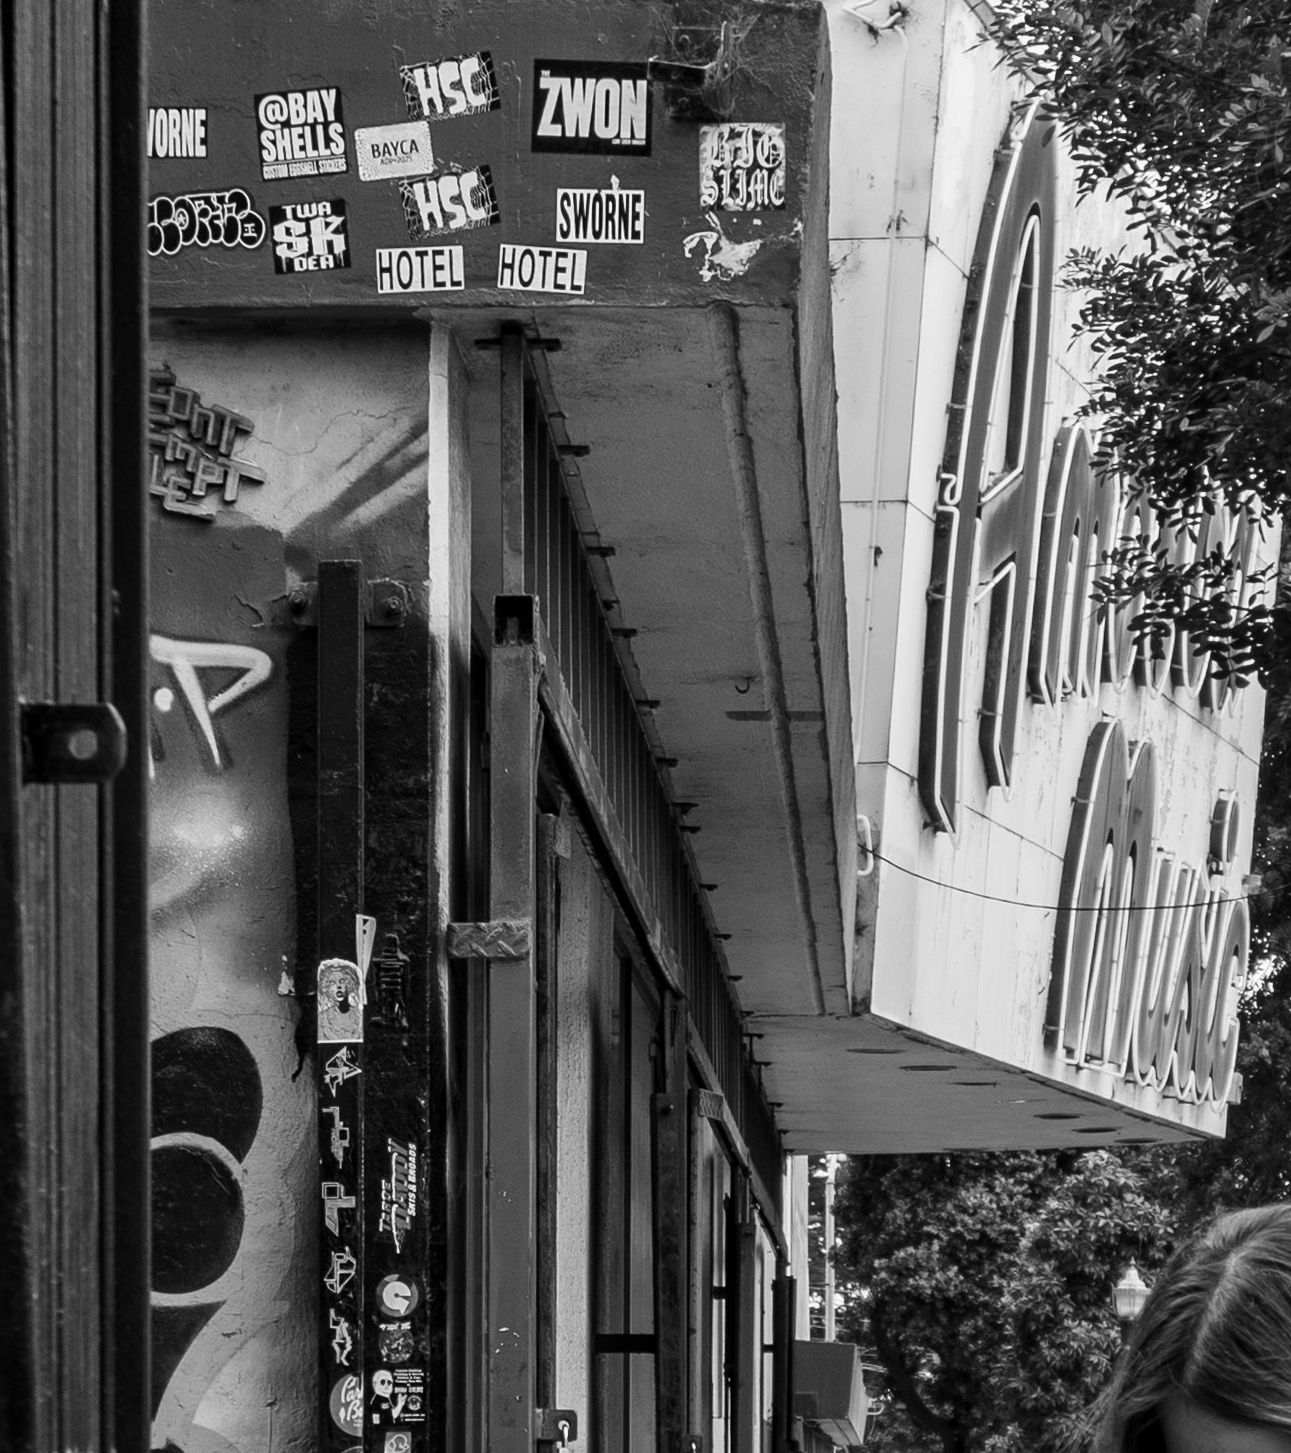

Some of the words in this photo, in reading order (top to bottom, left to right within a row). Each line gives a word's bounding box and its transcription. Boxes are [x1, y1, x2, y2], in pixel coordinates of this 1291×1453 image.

[413, 57, 487, 117] HSC
[537, 76, 647, 139] ZWON
[259, 89, 336, 130] @BAY
[260, 123, 345, 162] SHELLS
[371, 139, 420, 159] BAYCA
[282, 201, 332, 220] TWA
[413, 171, 487, 231] HSC
[560, 192, 642, 241] SWORNE
[378, 249, 462, 291] HOTEL
[500, 247, 584, 291] HOTEL
[1044, 713, 1251, 1111] Music
